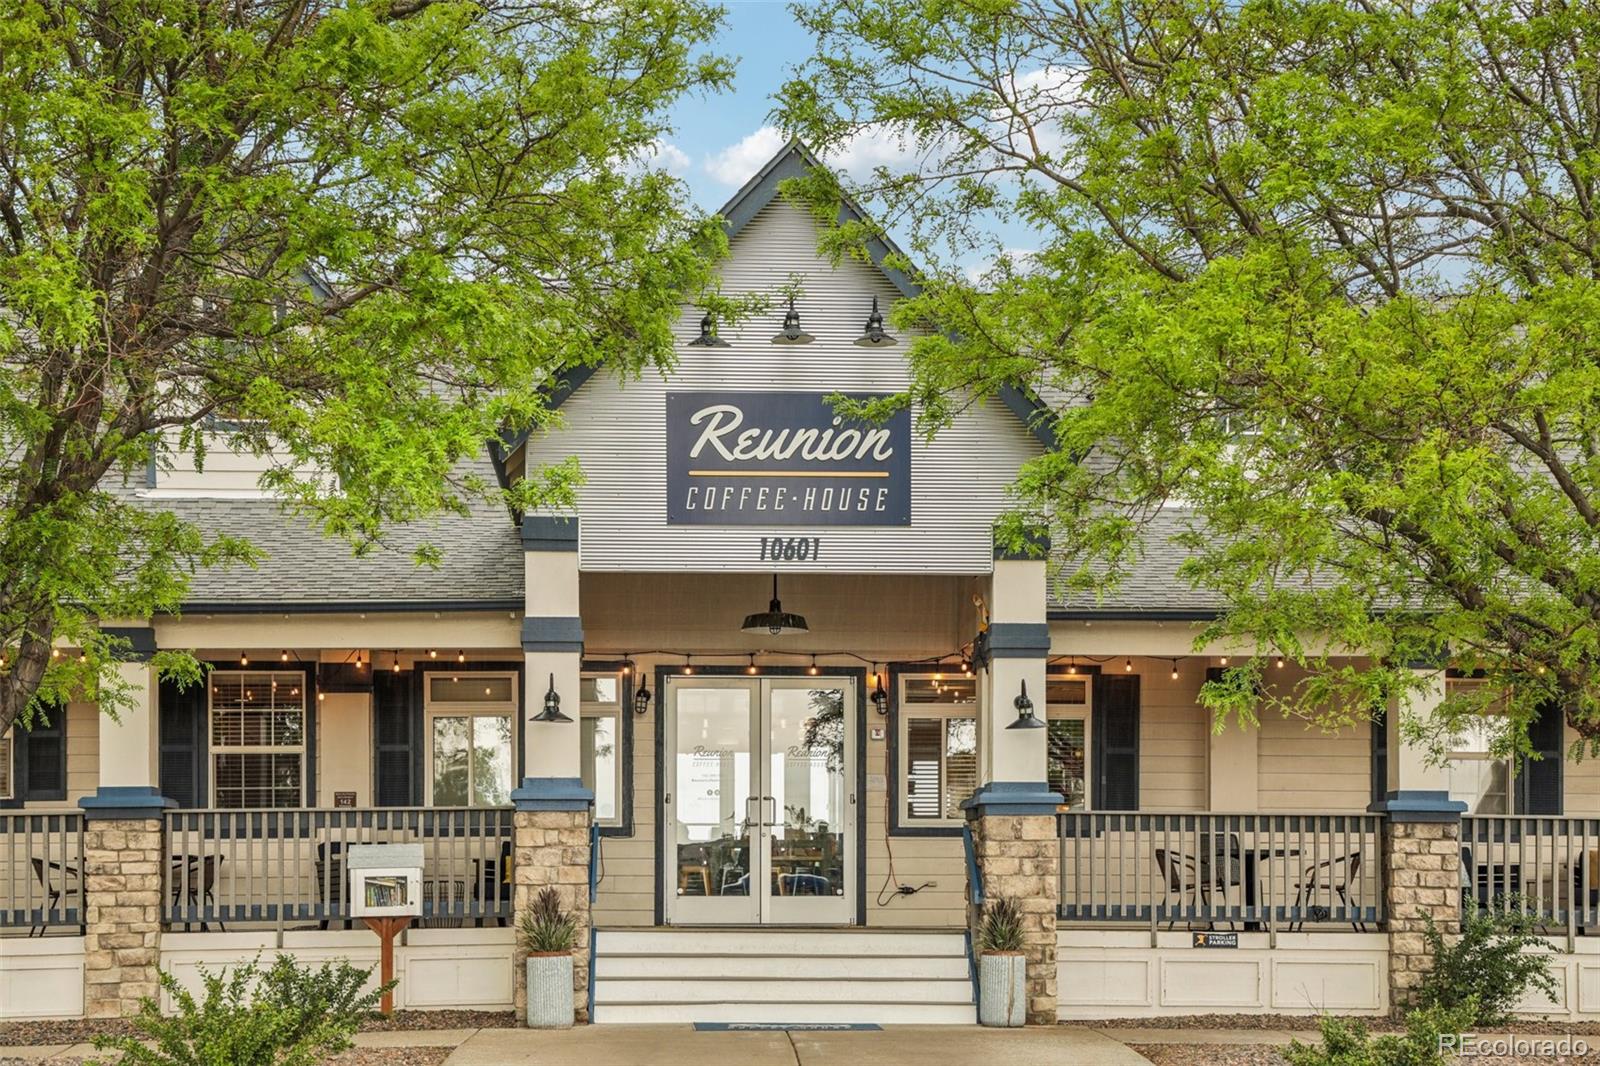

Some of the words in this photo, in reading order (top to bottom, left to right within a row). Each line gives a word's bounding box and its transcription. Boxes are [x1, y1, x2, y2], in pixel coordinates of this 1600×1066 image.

[689, 404, 894, 462] Reunion
[686, 486, 787, 511] COFFEE
[802, 487, 889, 512] HOUSE
[760, 537, 820, 561] 10601
